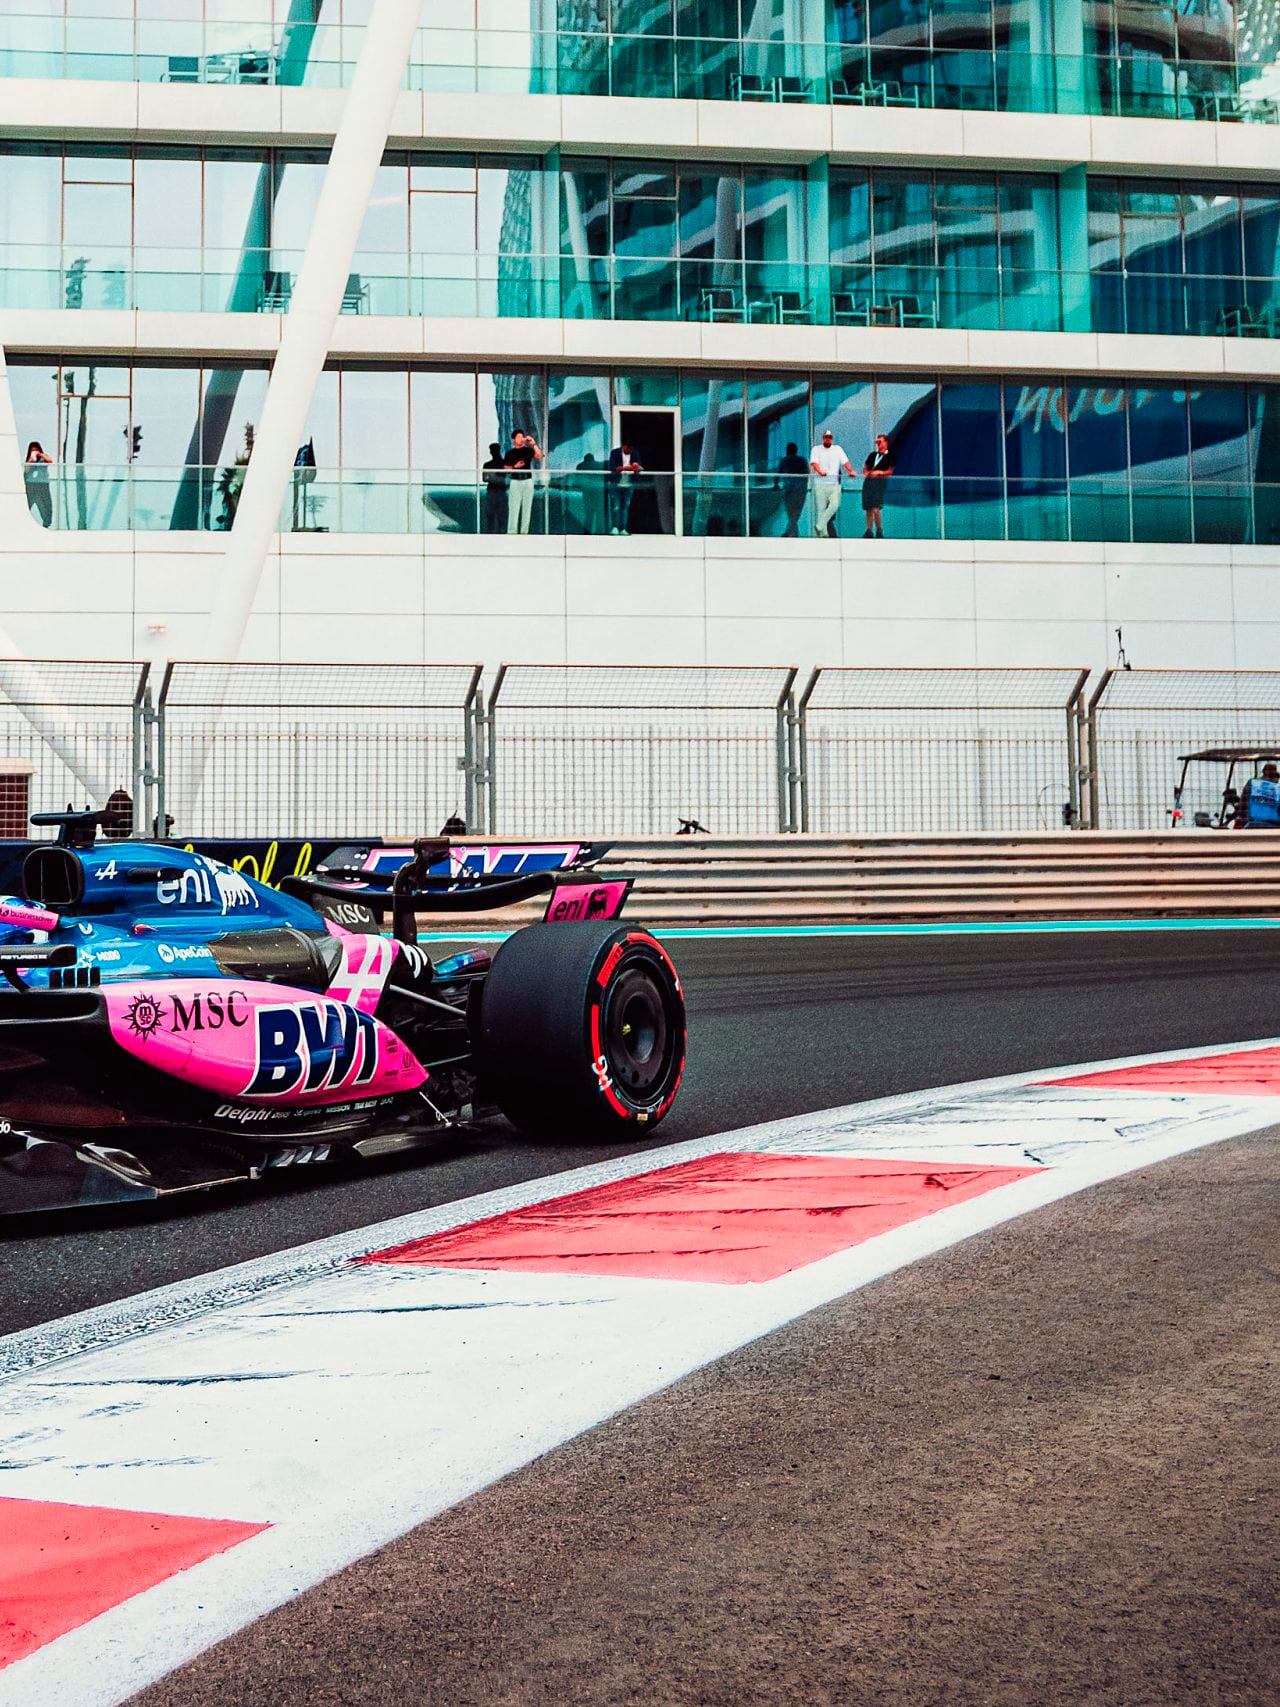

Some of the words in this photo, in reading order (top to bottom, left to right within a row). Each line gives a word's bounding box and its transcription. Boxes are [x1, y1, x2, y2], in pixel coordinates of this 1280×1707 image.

[157, 857, 212, 904] eni
[326, 904, 370, 924] MSC
[554, 892, 588, 920] eni
[168, 990, 249, 1033] MSC
[238, 1000, 379, 1096] BWT
[214, 1103, 274, 1124] Delphi
